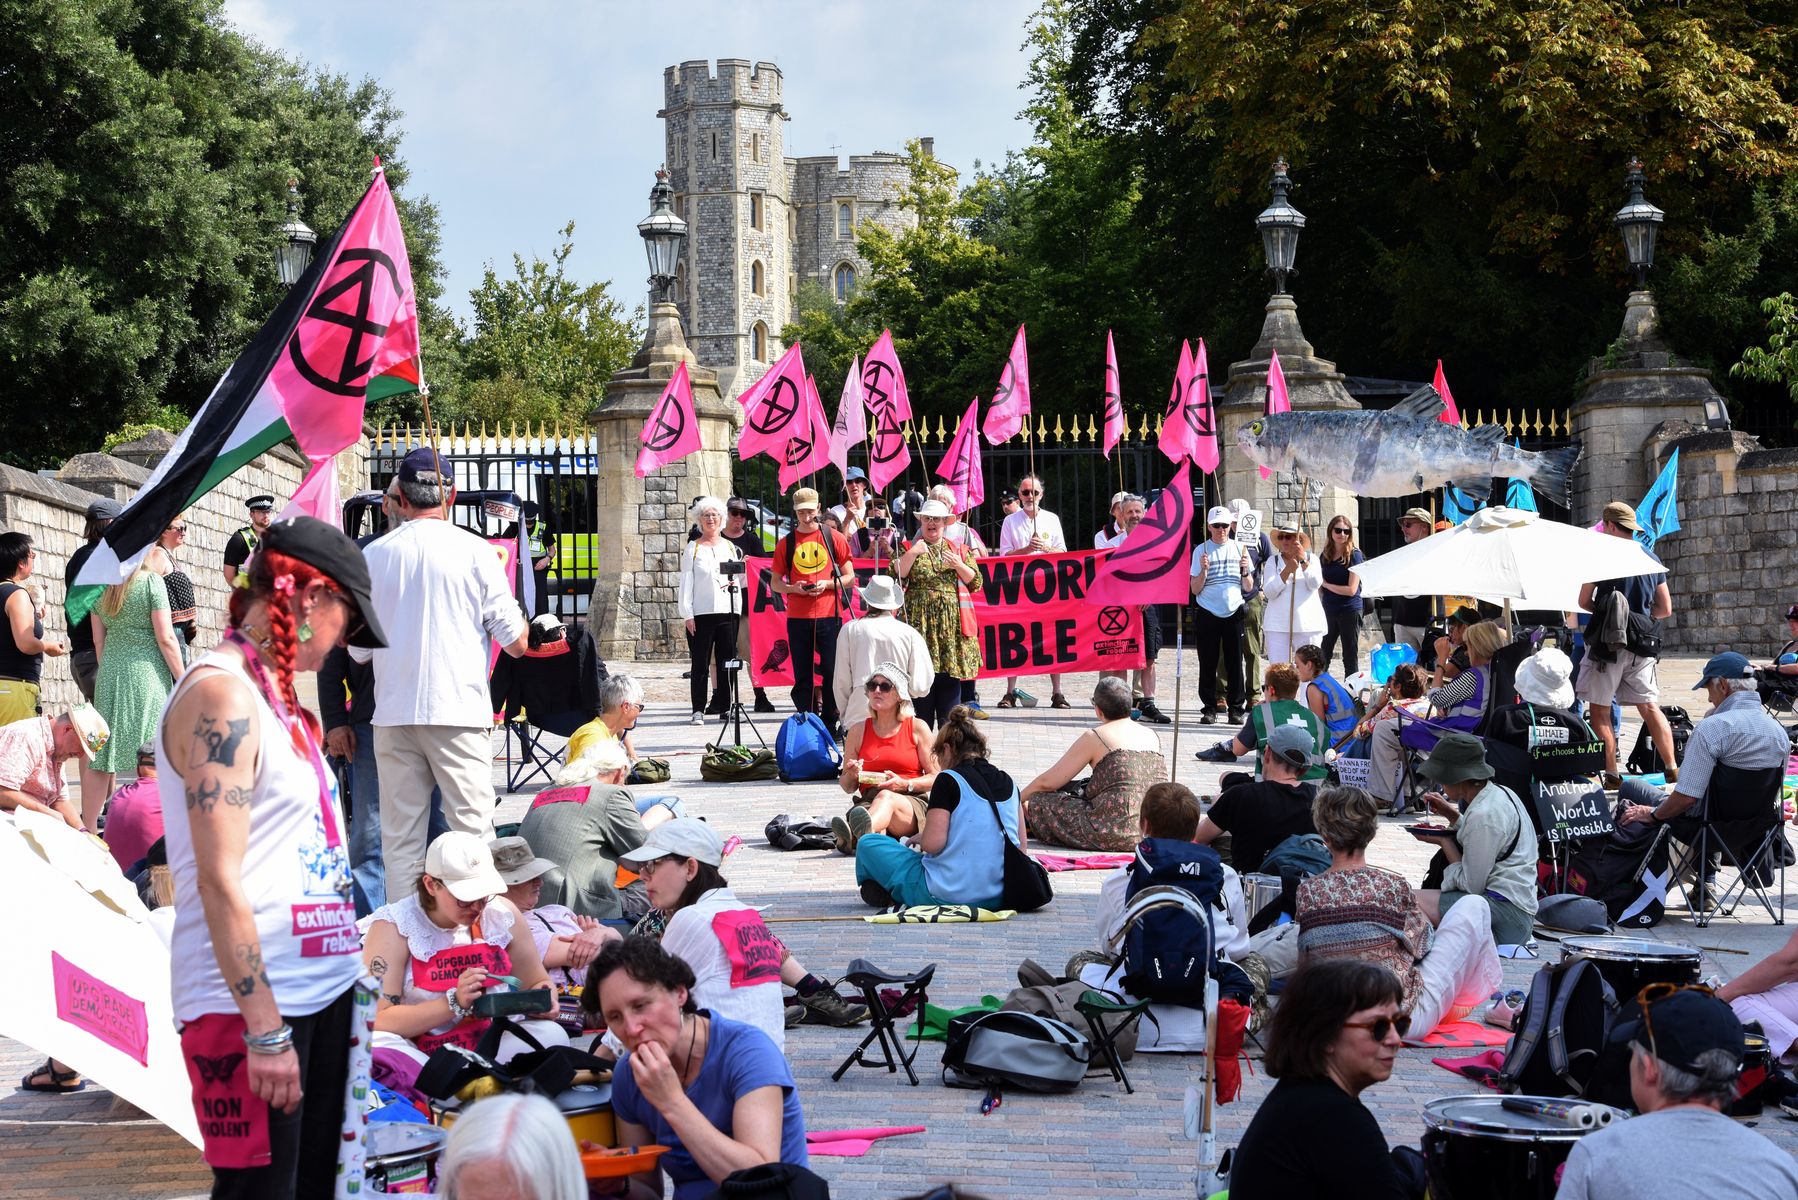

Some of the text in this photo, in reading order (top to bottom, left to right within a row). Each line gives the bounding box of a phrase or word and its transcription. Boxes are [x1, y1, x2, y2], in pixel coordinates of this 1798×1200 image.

[485, 502, 514, 518] PEOPLE
[977, 553, 1114, 605] WOR
[978, 619, 1078, 670] IBLE
[1095, 640, 1130, 649] extinction
[1106, 645, 1138, 655] rebellion
[1533, 747, 1540, 760] if
[1552, 747, 1575, 756] choose
[1577, 746, 1585, 754] to
[1587, 742, 1604, 754] ACT
[1345, 775, 1367, 783] BECAME
[1540, 780, 1595, 798] Another
[1551, 800, 1601, 821] World
[1566, 820, 1614, 840] possible
[436, 954, 483, 969] UPGRADE
[73, 979, 133, 1025] UPGRADE
[202, 1097, 242, 1118] NON
